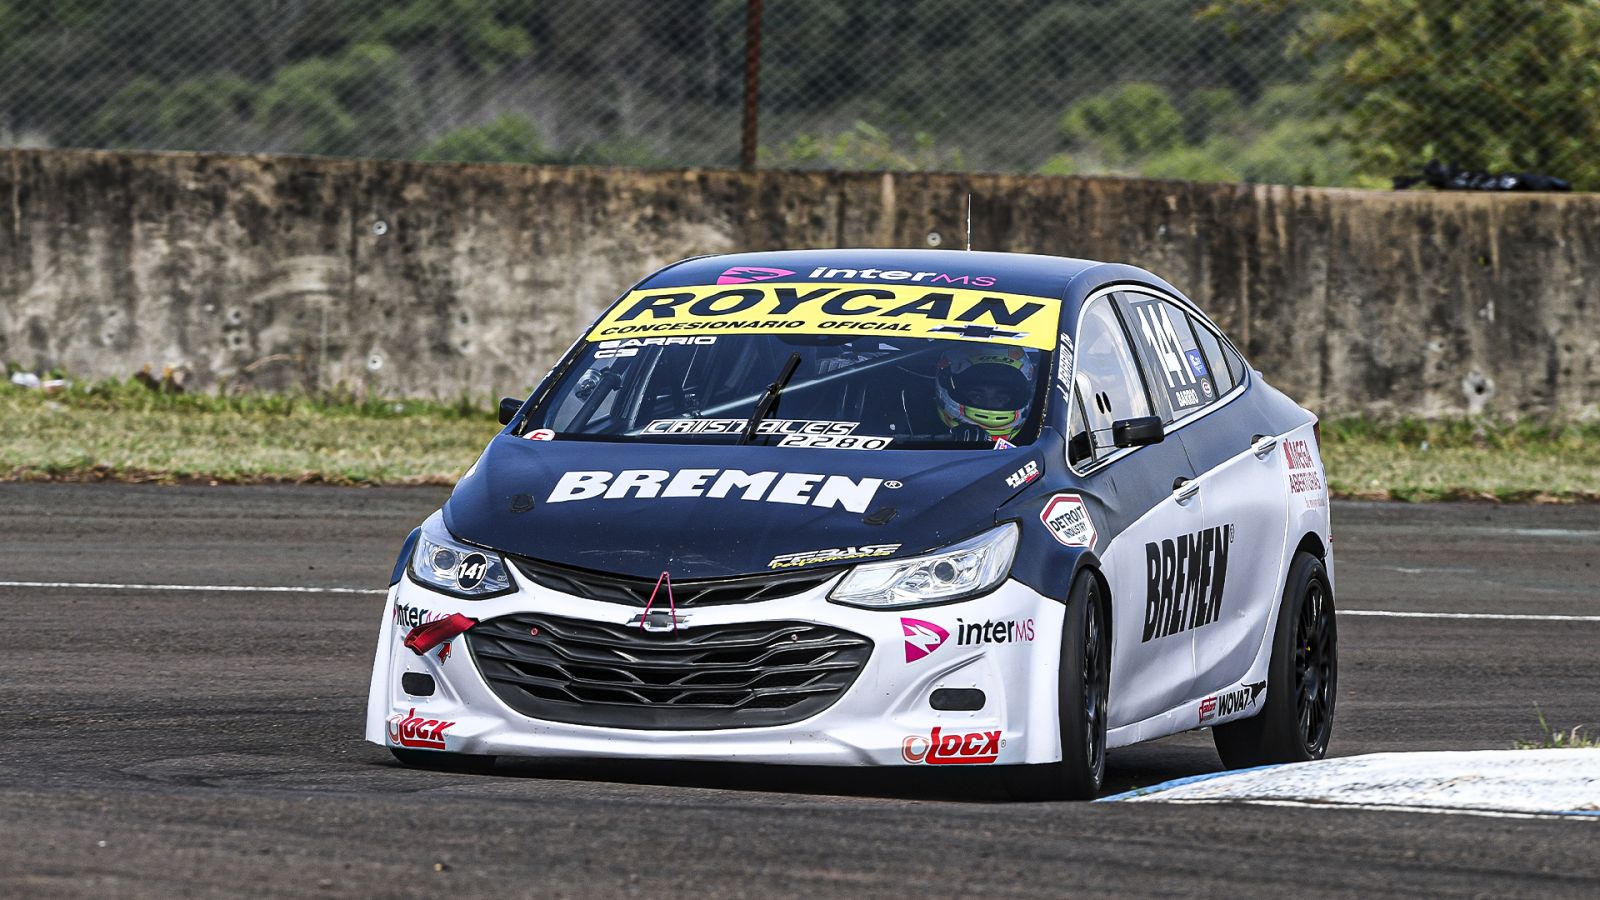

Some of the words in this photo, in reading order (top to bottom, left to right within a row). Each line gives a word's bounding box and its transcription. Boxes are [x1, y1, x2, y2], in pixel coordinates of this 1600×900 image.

[808, 266, 996, 288] interMS
[615, 287, 1045, 326] ROYCAN
[600, 320, 805, 336] CONCESIONARIO
[817, 321, 913, 333] OFICIAL
[1136, 303, 1197, 387] 141
[785, 436, 888, 449] 2280
[1049, 505, 1086, 532] DETROIT
[459, 562, 486, 580] 141
[956, 618, 1035, 646] interMS
